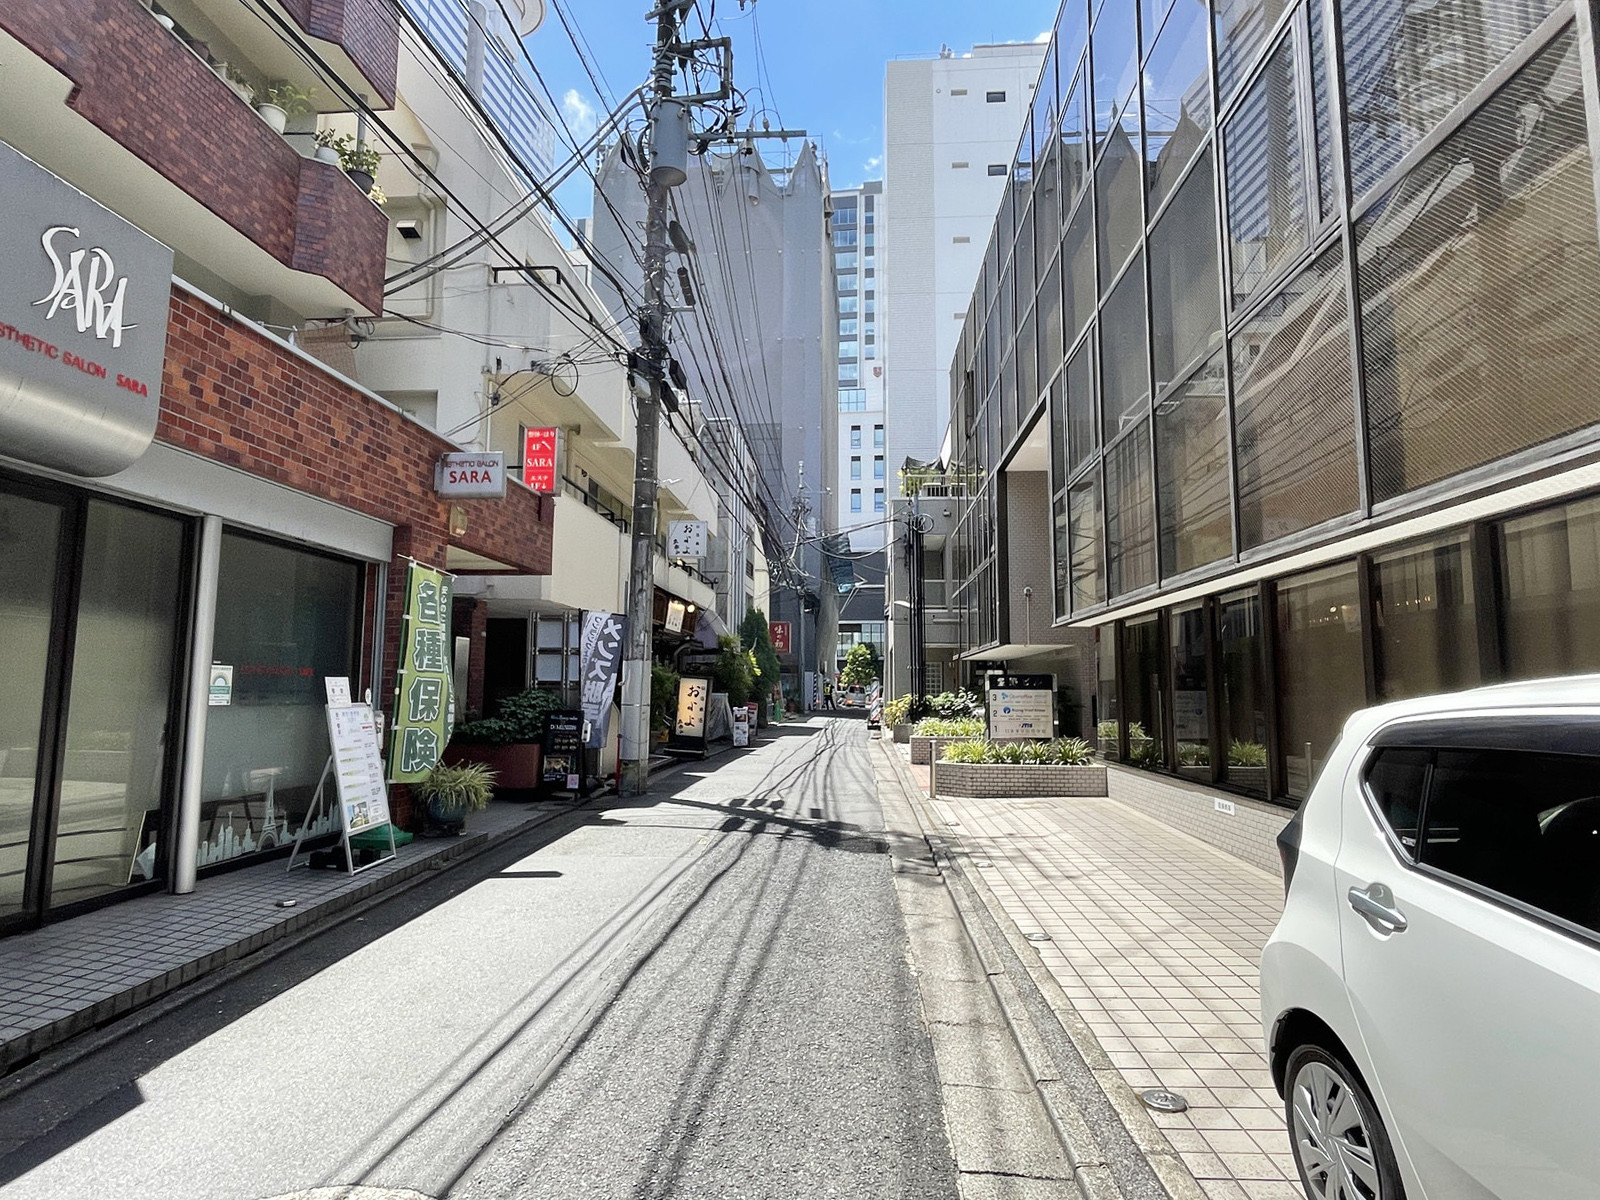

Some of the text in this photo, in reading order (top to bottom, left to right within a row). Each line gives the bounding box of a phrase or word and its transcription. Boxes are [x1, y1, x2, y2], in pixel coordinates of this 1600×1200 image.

[30, 225, 139, 348] SARA
[62, 349, 107, 379] SALON
[116, 373, 148, 398] SARA
[527, 458, 553, 467] SARA
[449, 470, 492, 484] SARA
[401, 580, 443, 774] 各種保険
[992, 693, 998, 701] 3
[992, 709, 998, 717] 2
